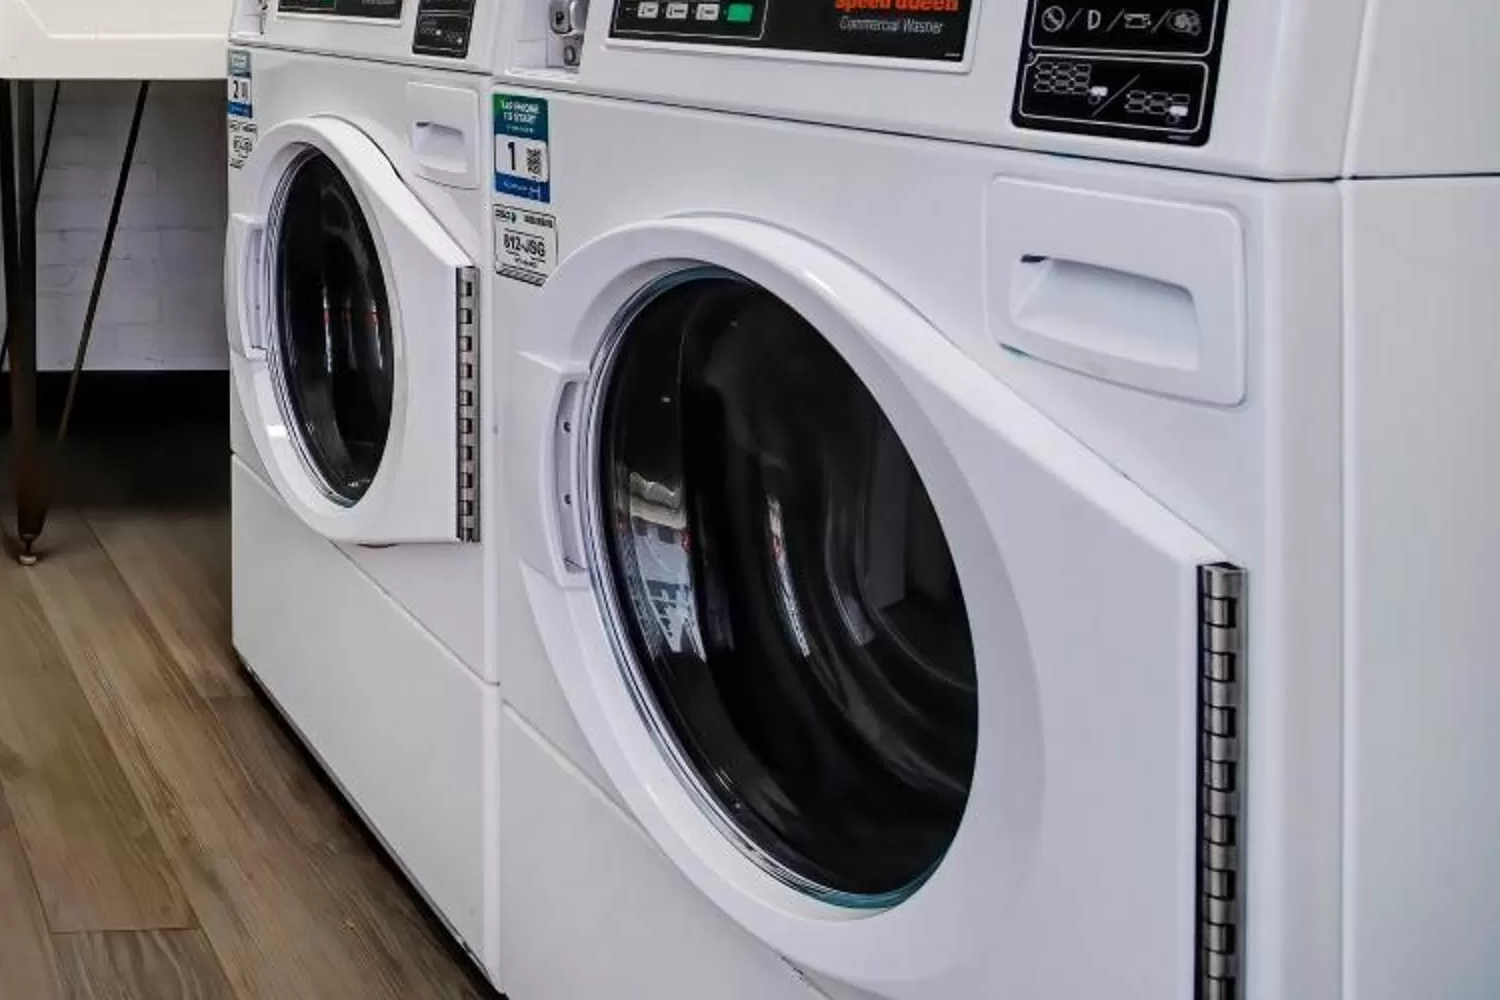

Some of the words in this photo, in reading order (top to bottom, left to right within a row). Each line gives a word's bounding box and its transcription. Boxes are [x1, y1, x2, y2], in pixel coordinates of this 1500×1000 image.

[838, 15, 900, 32] Commercial
[902, 17, 945, 35] Washer
[232, 79, 240, 100] 2
[507, 141, 517, 171] 1
